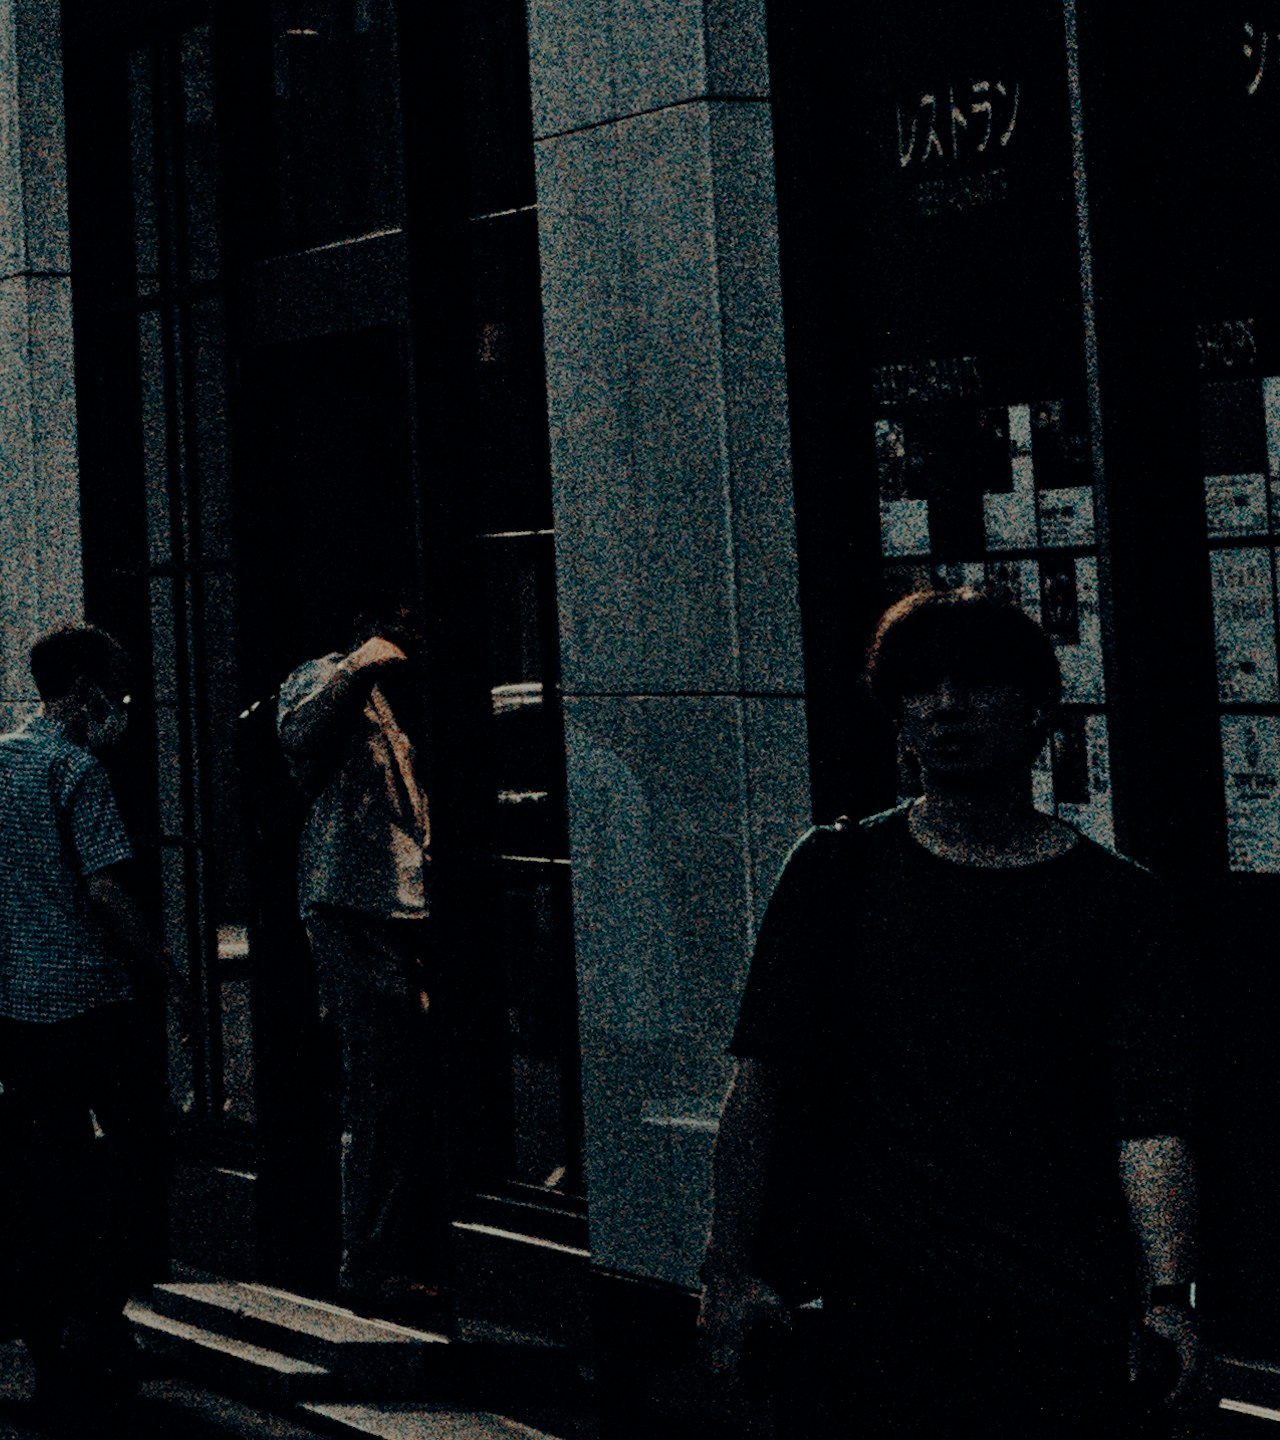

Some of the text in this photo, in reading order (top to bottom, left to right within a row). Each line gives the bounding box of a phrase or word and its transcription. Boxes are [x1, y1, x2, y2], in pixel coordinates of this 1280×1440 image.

[1241, 20, 1280, 96] シ
[894, 79, 1021, 169] レストラン
